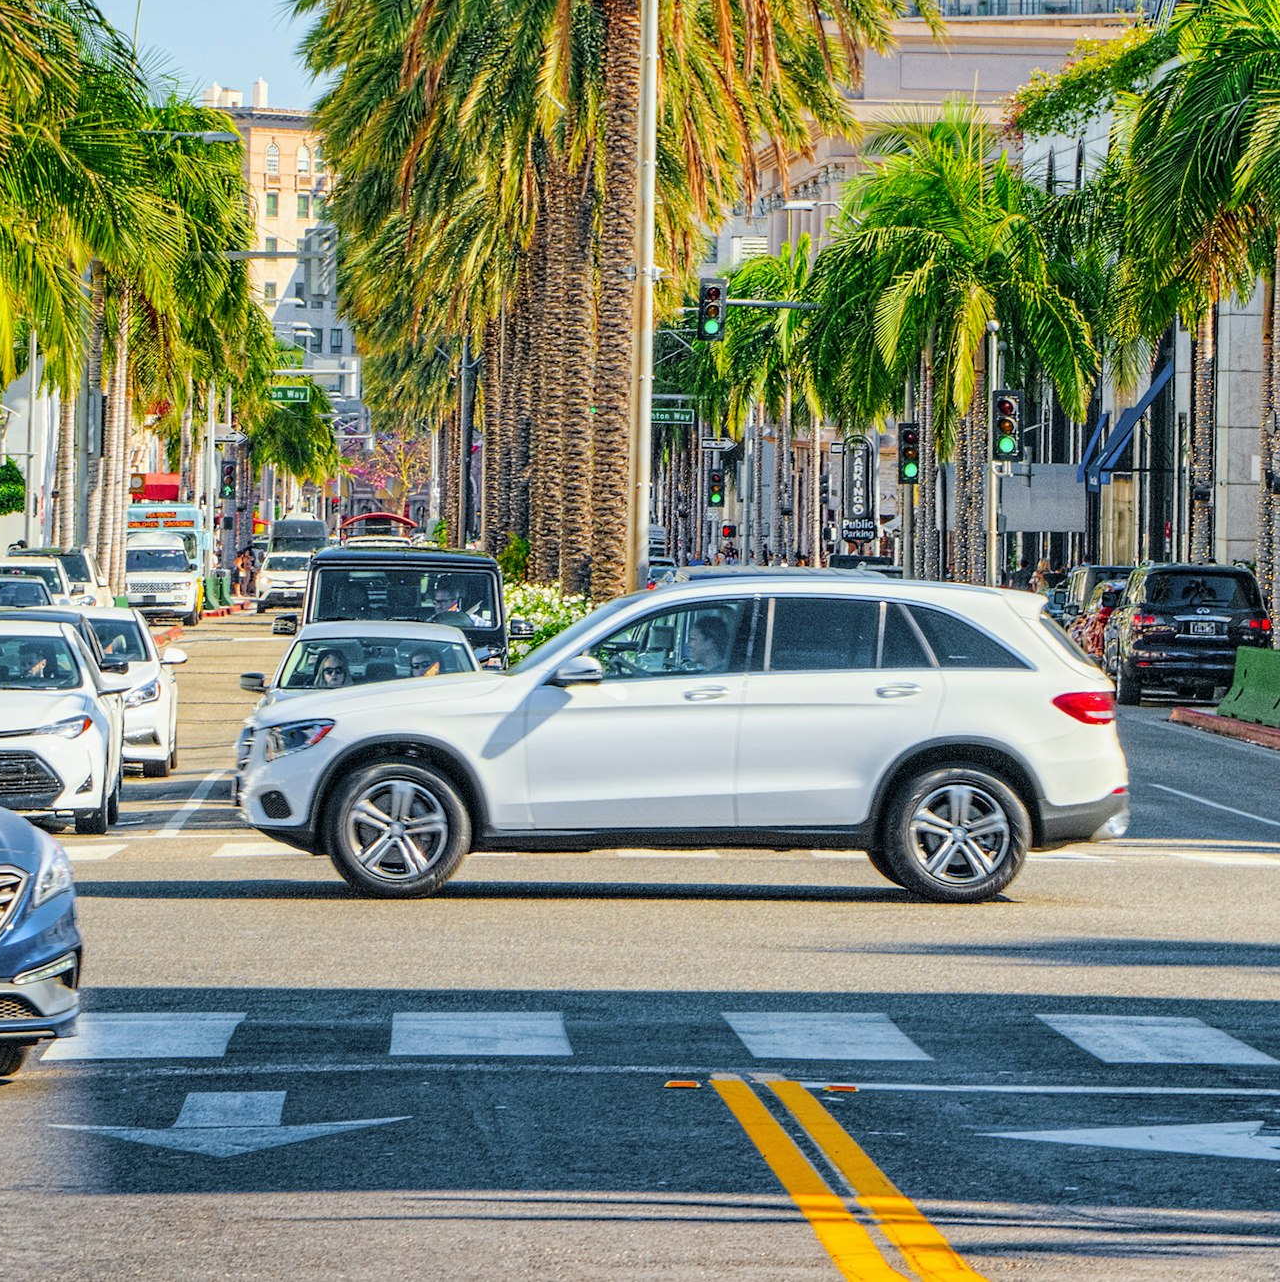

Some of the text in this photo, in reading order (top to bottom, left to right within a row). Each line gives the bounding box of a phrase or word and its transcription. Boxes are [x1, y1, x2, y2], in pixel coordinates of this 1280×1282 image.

[673, 412, 691, 421] Way
[852, 449, 864, 504] PARKING
[842, 519, 874, 529] Public
[842, 530, 874, 539] Parking
